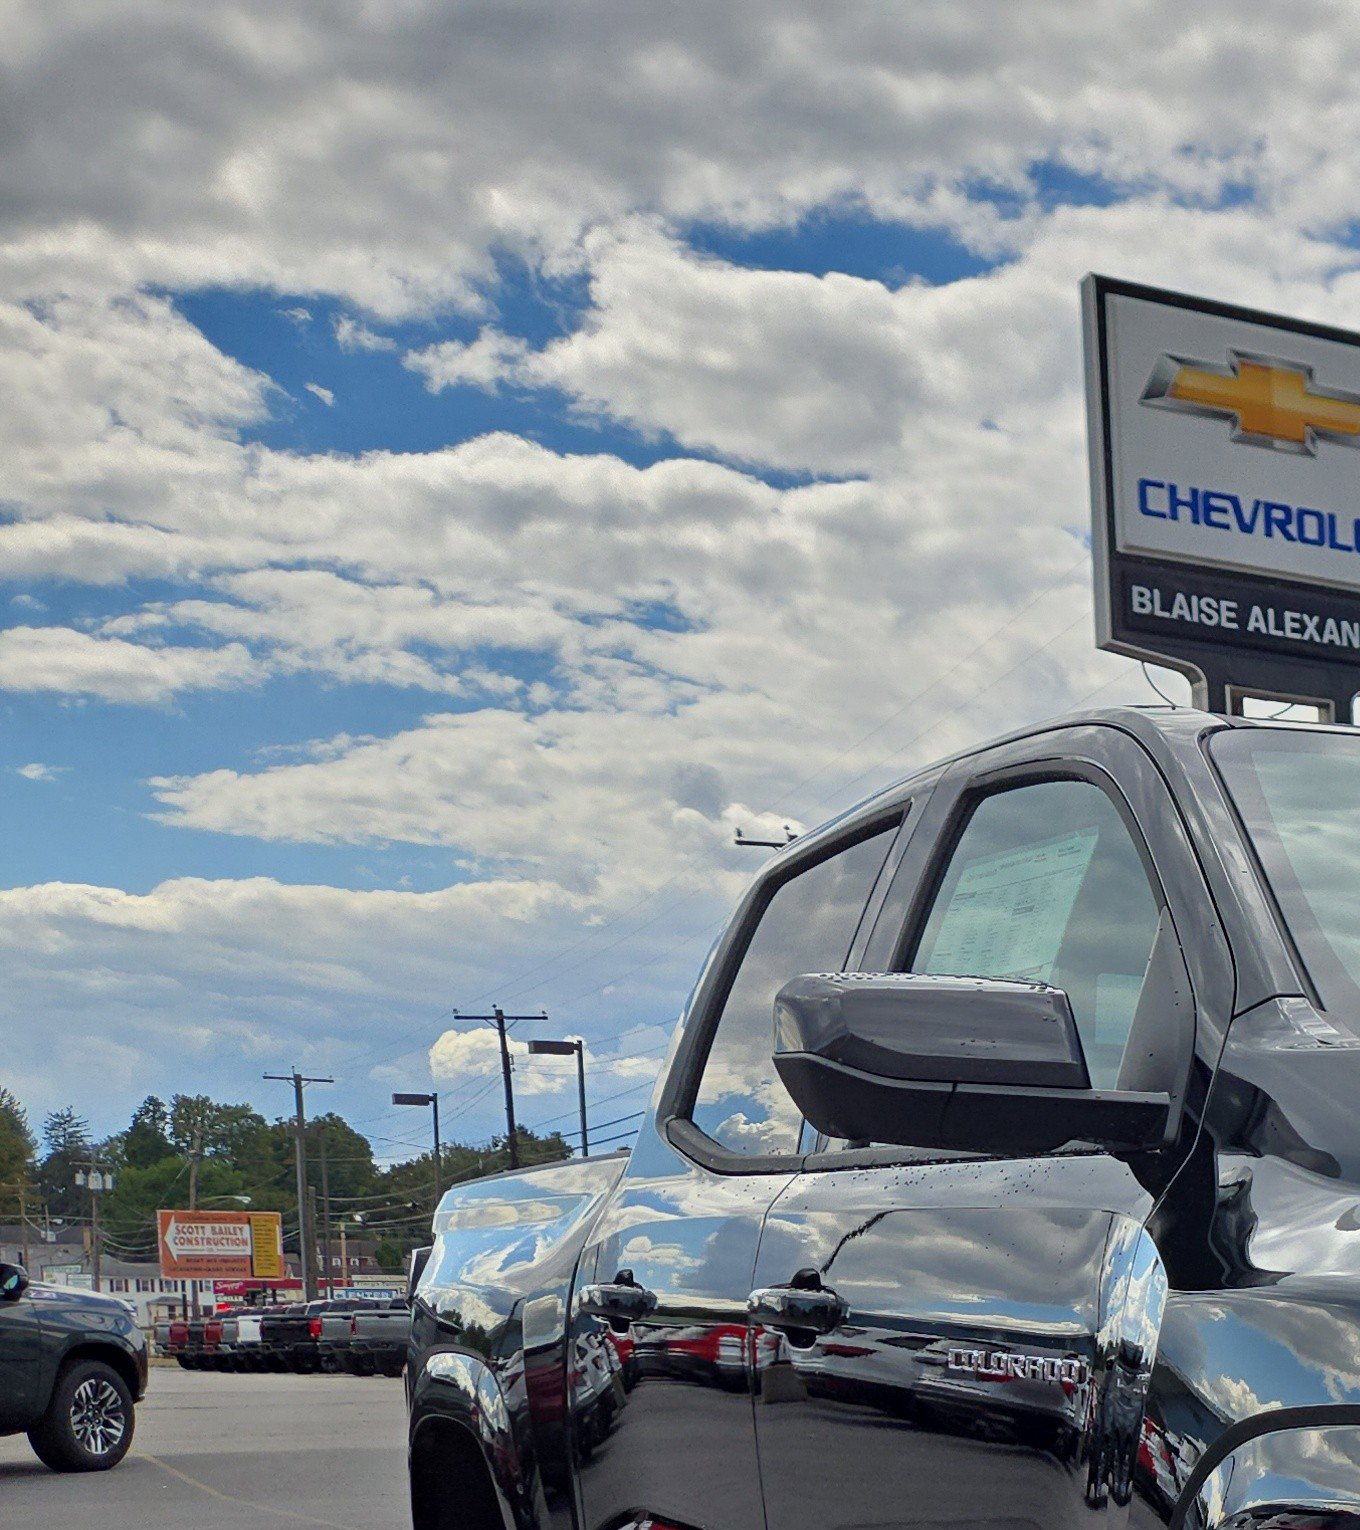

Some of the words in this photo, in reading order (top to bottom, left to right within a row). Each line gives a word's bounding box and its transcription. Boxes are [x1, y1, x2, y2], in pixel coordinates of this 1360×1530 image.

[1131, 584, 1240, 631] BLAISE
[174, 1225, 205, 1236] SCOTT
[211, 1225, 244, 1236] BAILEY
[173, 1236, 248, 1247] CONSTRUCTION
